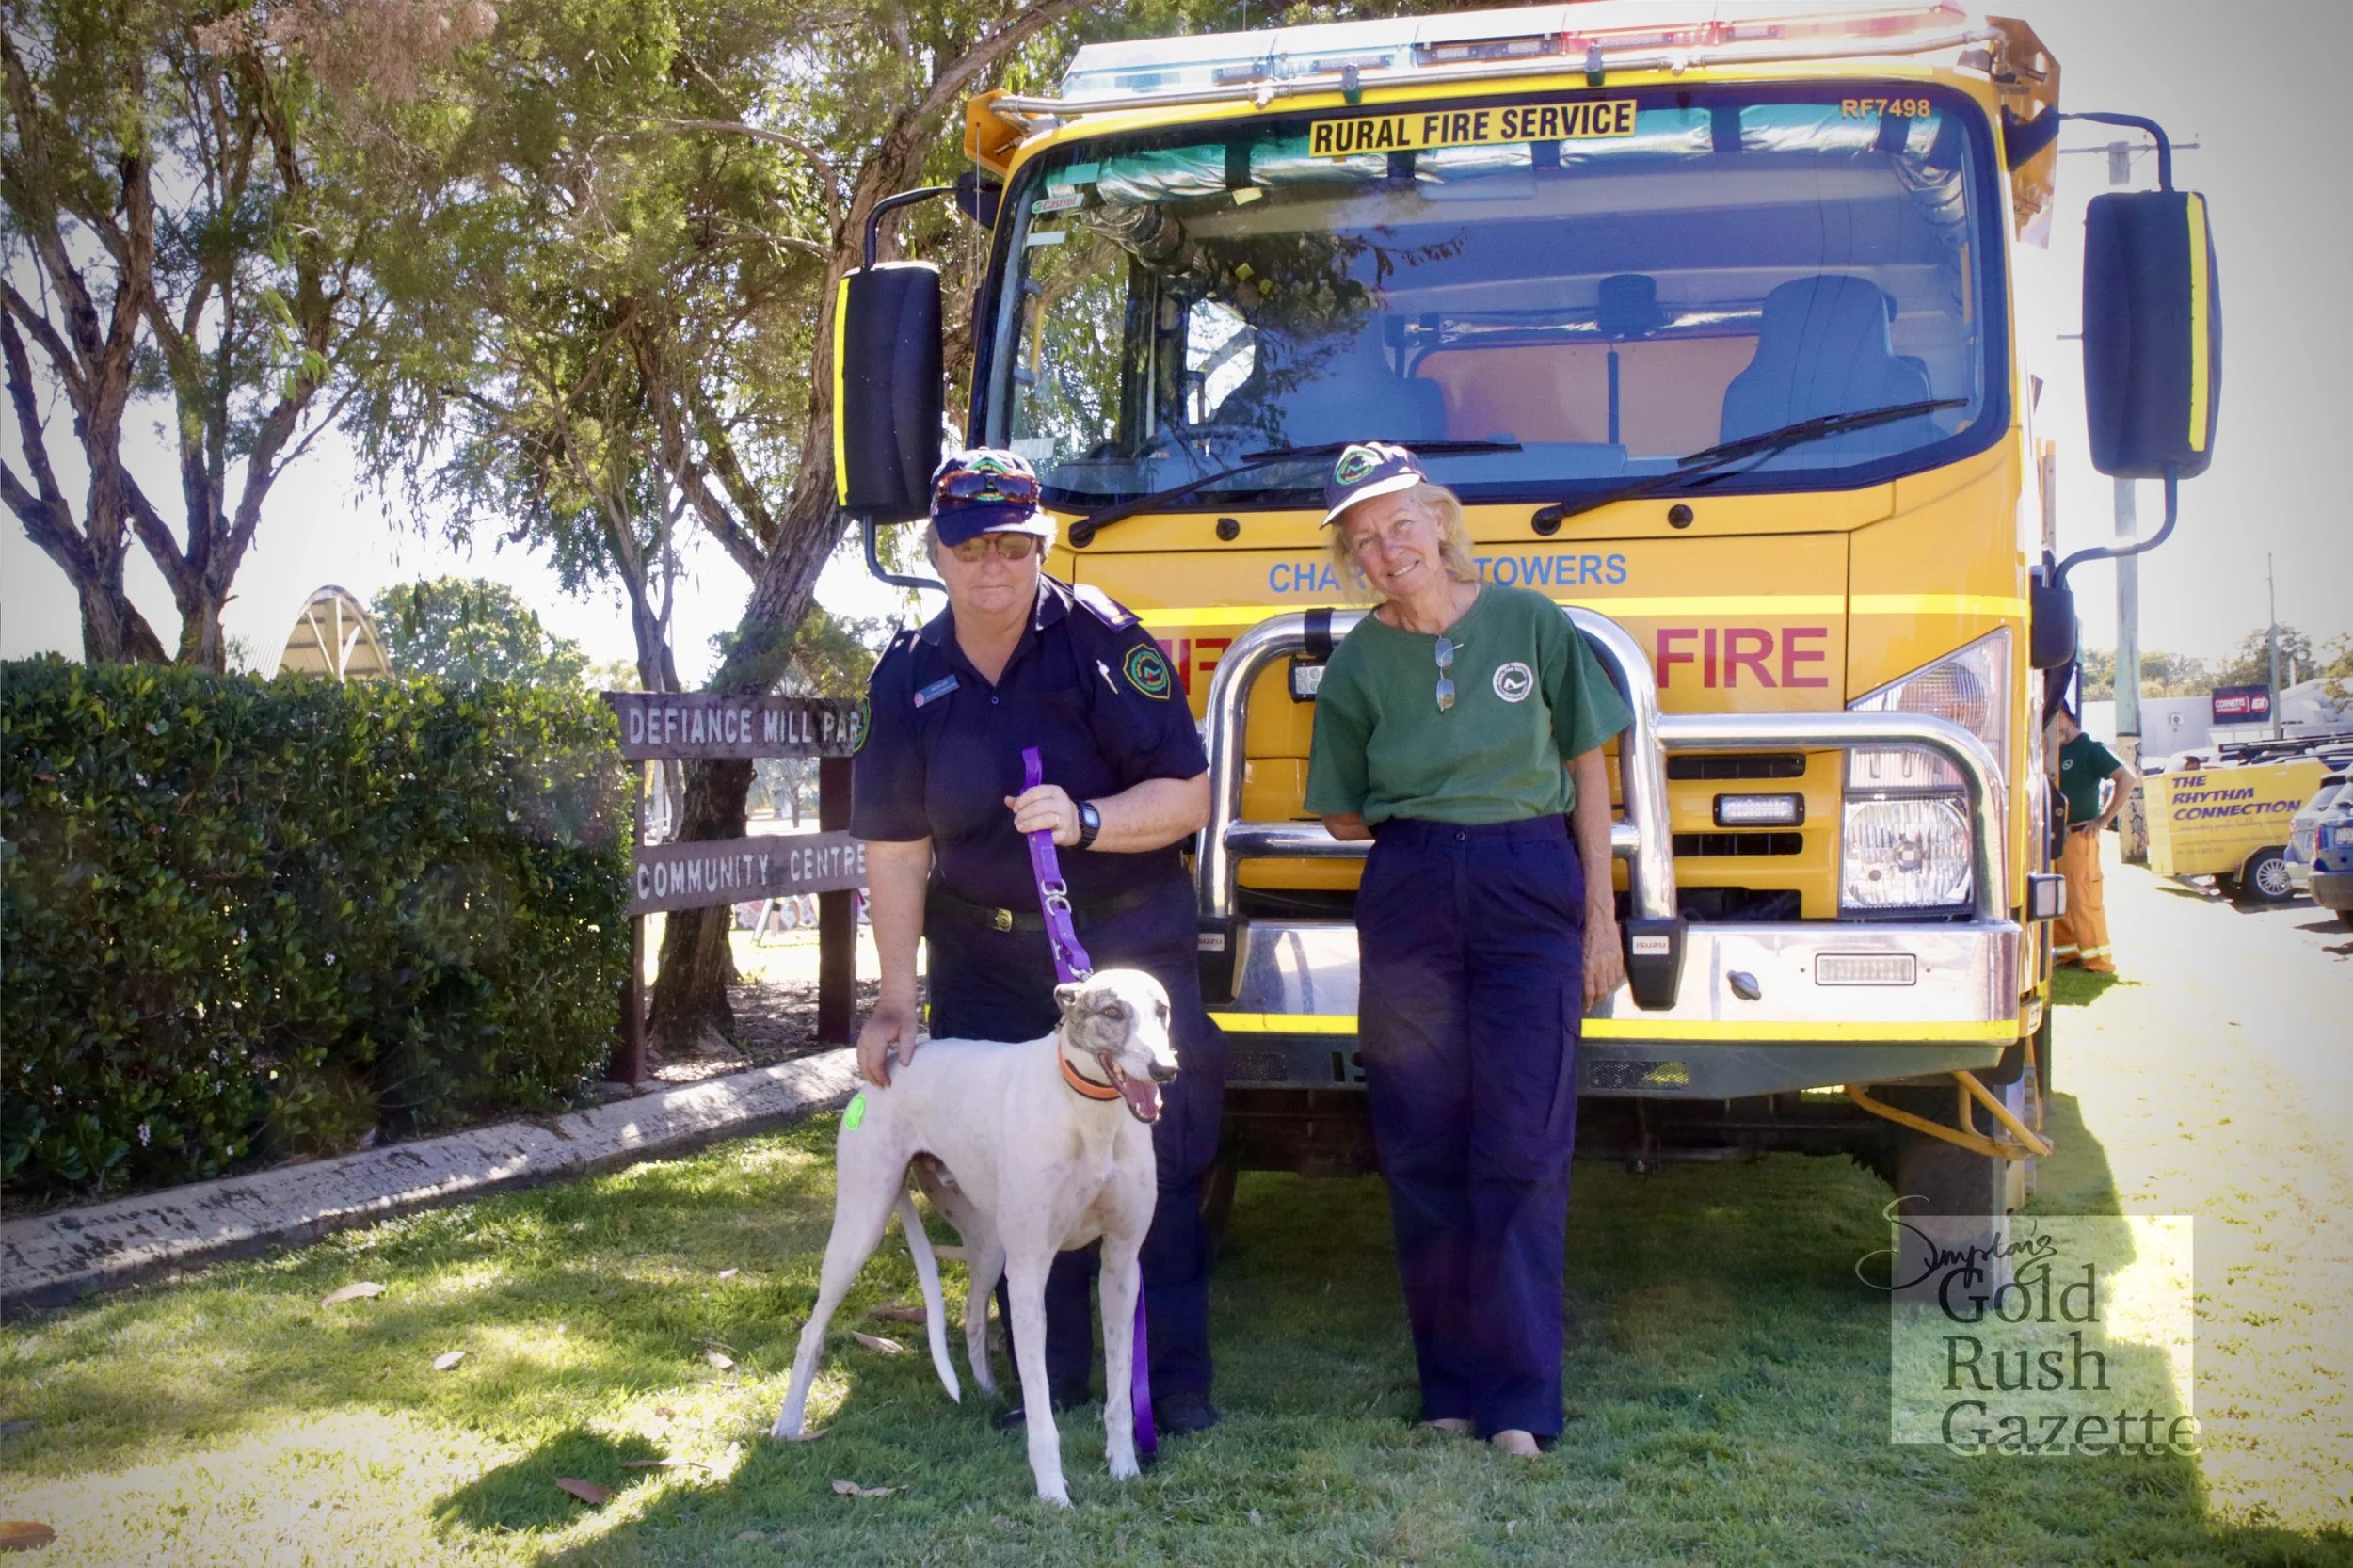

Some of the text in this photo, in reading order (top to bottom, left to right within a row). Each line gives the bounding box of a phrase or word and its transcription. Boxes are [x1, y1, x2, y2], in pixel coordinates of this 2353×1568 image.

[1841, 99, 1931, 119] RF7498
[1314, 103, 1632, 153] RURAL FIRE SERVICE
[1474, 553, 1628, 587] TOWERS
[1657, 627, 1830, 689] FIRE
[629, 707, 859, 745] DEFIANCE MILL PAR
[2172, 775, 2207, 789] THE
[2172, 788, 2255, 805] RHYTHM
[2173, 800, 2302, 821] CONNECTION
[636, 845, 867, 900] COMMUNITY CENTRE
